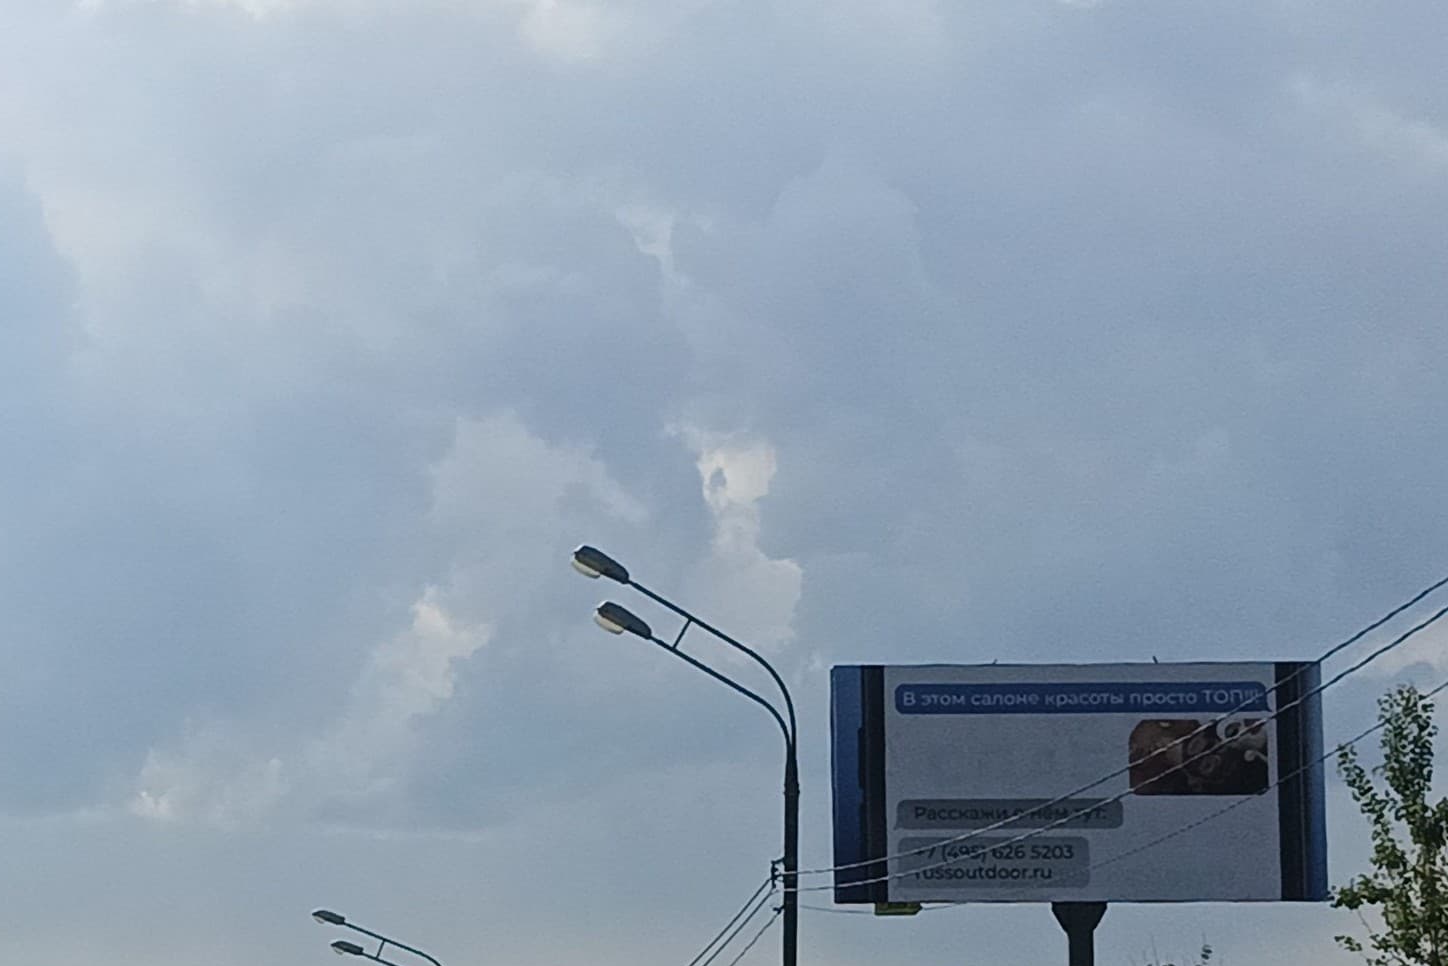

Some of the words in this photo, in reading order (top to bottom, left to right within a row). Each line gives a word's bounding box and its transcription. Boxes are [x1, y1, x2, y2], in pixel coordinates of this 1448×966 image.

[903, 692, 916, 706] В
[921, 694, 966, 706] этом
[971, 693, 1040, 706] салоне
[1045, 693, 1124, 708] красоты
[1129, 692, 1197, 707] просто
[914, 806, 1007, 821] Расскажи
[992, 844, 1026, 860] 626
[1030, 844, 1074, 860] 5203
[915, 864, 1053, 880] russoutdoor.ru
